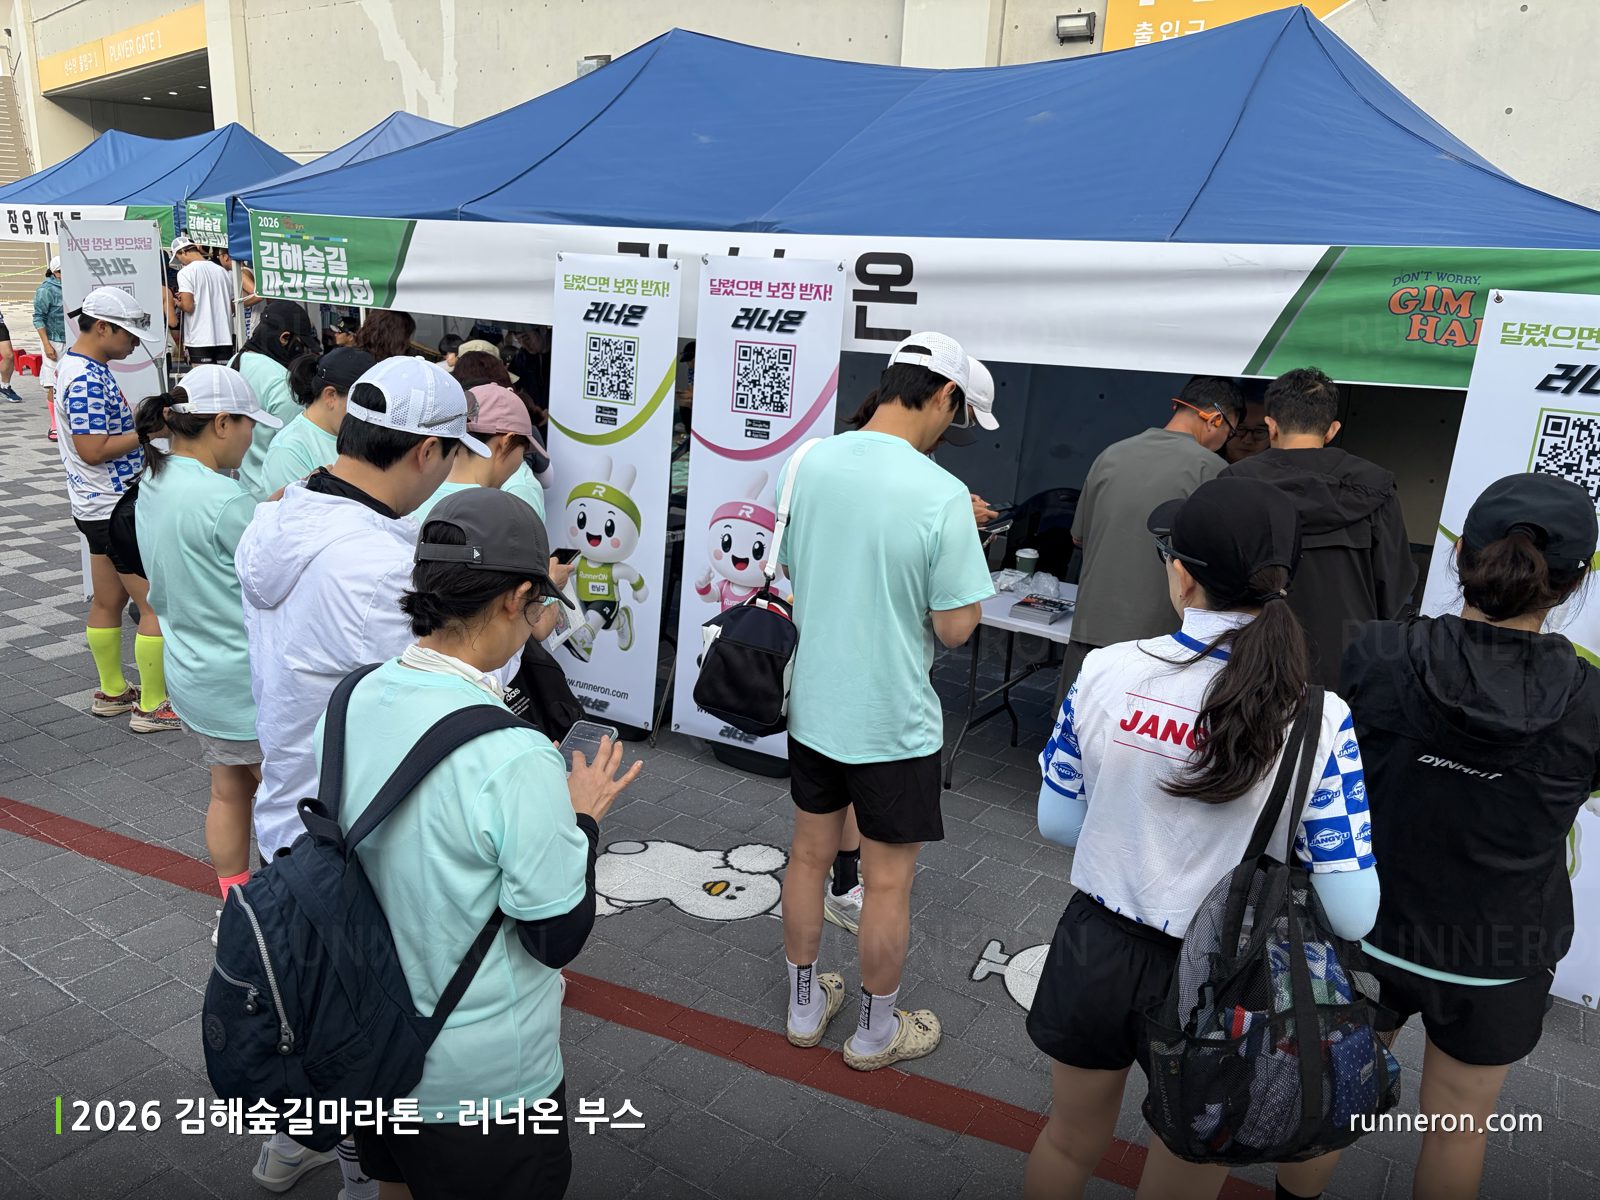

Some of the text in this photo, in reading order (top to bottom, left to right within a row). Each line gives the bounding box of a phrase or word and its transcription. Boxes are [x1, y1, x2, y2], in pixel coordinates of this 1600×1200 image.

[108, 39, 135, 63] PLAYER
[136, 31, 155, 55] GATE
[258, 216, 279, 228] 2026
[259, 241, 348, 275] 김해숲길
[262, 270, 374, 306] 마라톤대회
[564, 274, 670, 298] 달렸으면 보장 받자!
[710, 278, 833, 302] 달렸으면 보장 받자!
[1392, 271, 1433, 287] DON'T
[583, 302, 649, 327] 러너온
[1388, 285, 1477, 319] GIM
[731, 307, 807, 334] 러너온
[1309, 831, 1350, 846] JANGYU
